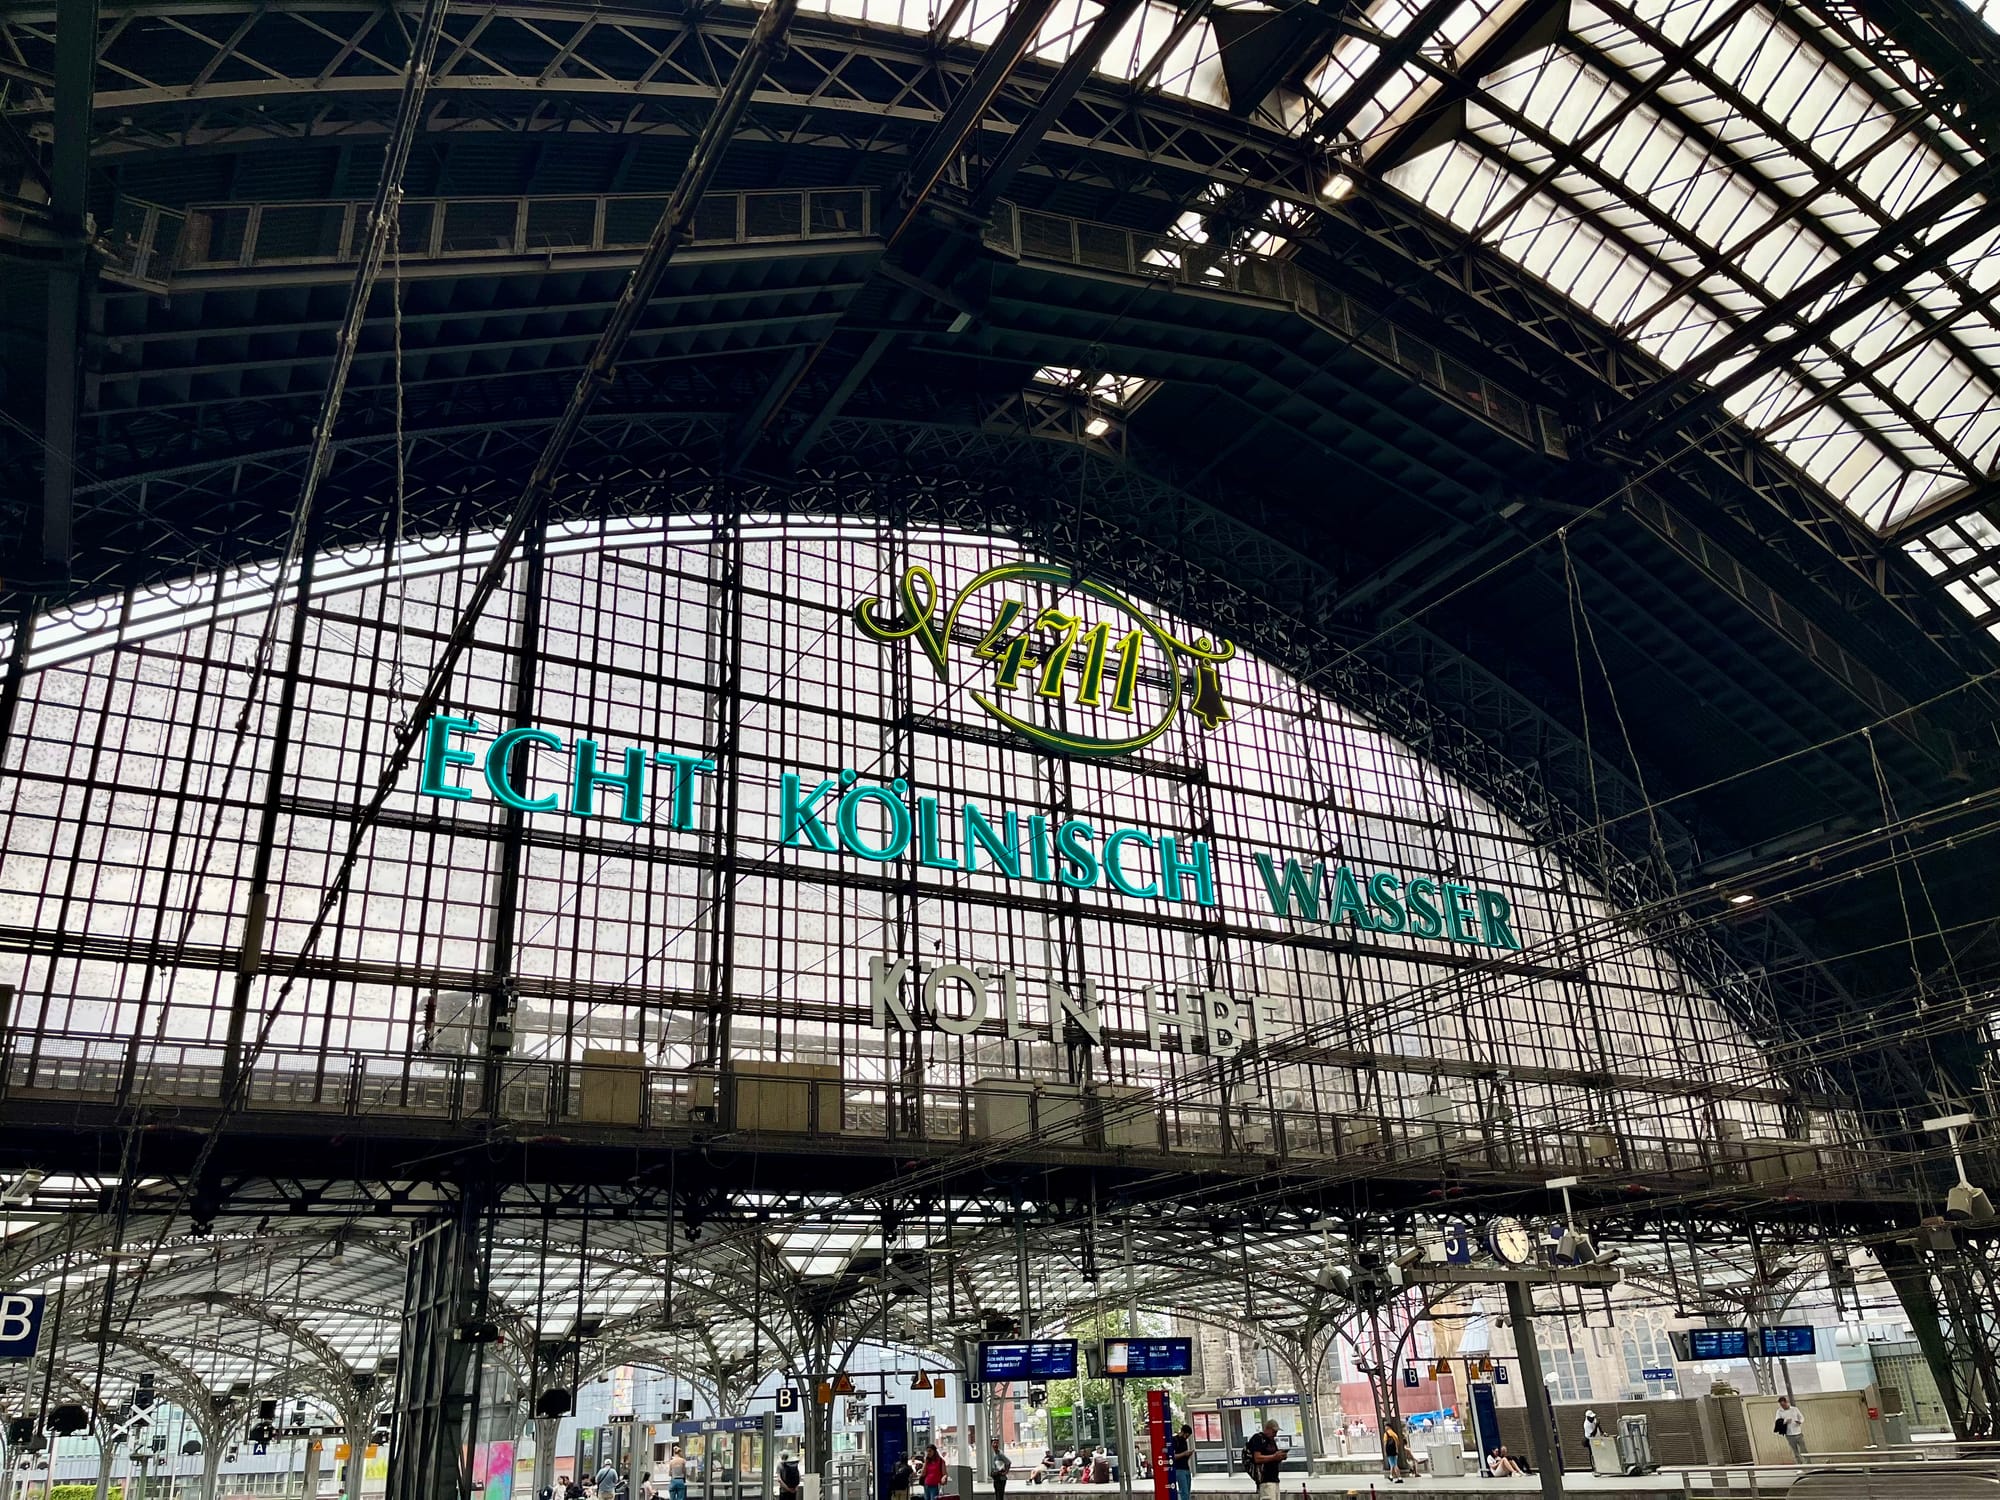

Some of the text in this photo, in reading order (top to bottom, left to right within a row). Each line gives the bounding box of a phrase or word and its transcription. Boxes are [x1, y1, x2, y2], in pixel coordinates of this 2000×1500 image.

[973, 601, 1143, 714] 4711
[421, 714, 1521, 950] ECHT KÖLNISCH WASSER
[869, 955, 1101, 1046] KÖLN
[1444, 1226, 1459, 1255] 5
[0, 1296, 34, 1341] B
[1409, 1370, 1417, 1383] B
[1500, 1368, 1507, 1380] B
[780, 1389, 791, 1407] B
[970, 1382, 980, 1398] B
[255, 1443, 263, 1454] A
